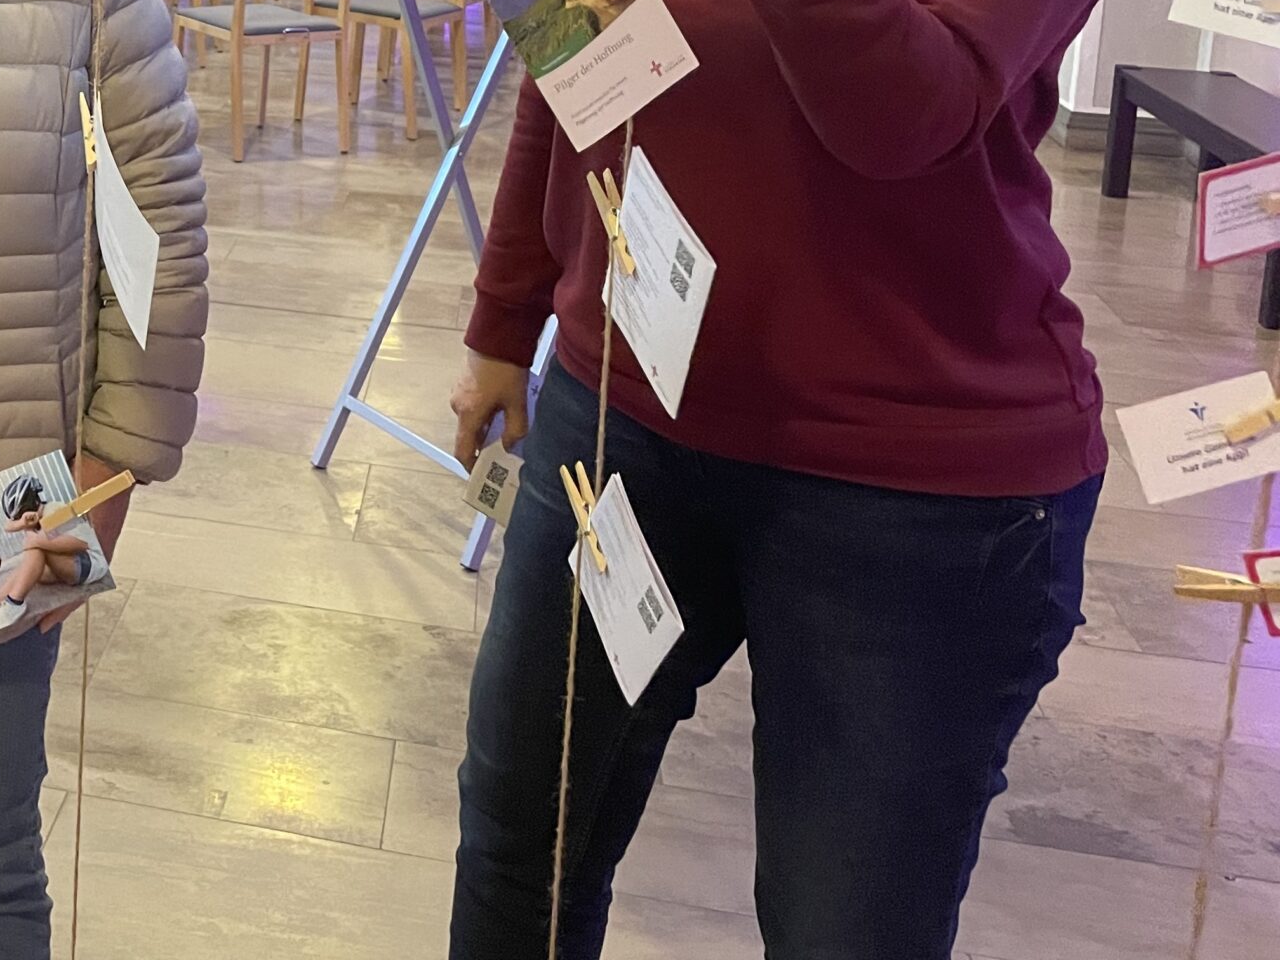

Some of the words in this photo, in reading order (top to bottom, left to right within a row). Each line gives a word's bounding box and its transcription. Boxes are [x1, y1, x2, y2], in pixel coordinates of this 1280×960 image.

[553, 72, 580, 94] Pilger
[580, 62, 594, 75] der
[593, 33, 634, 65] Hoffnung
